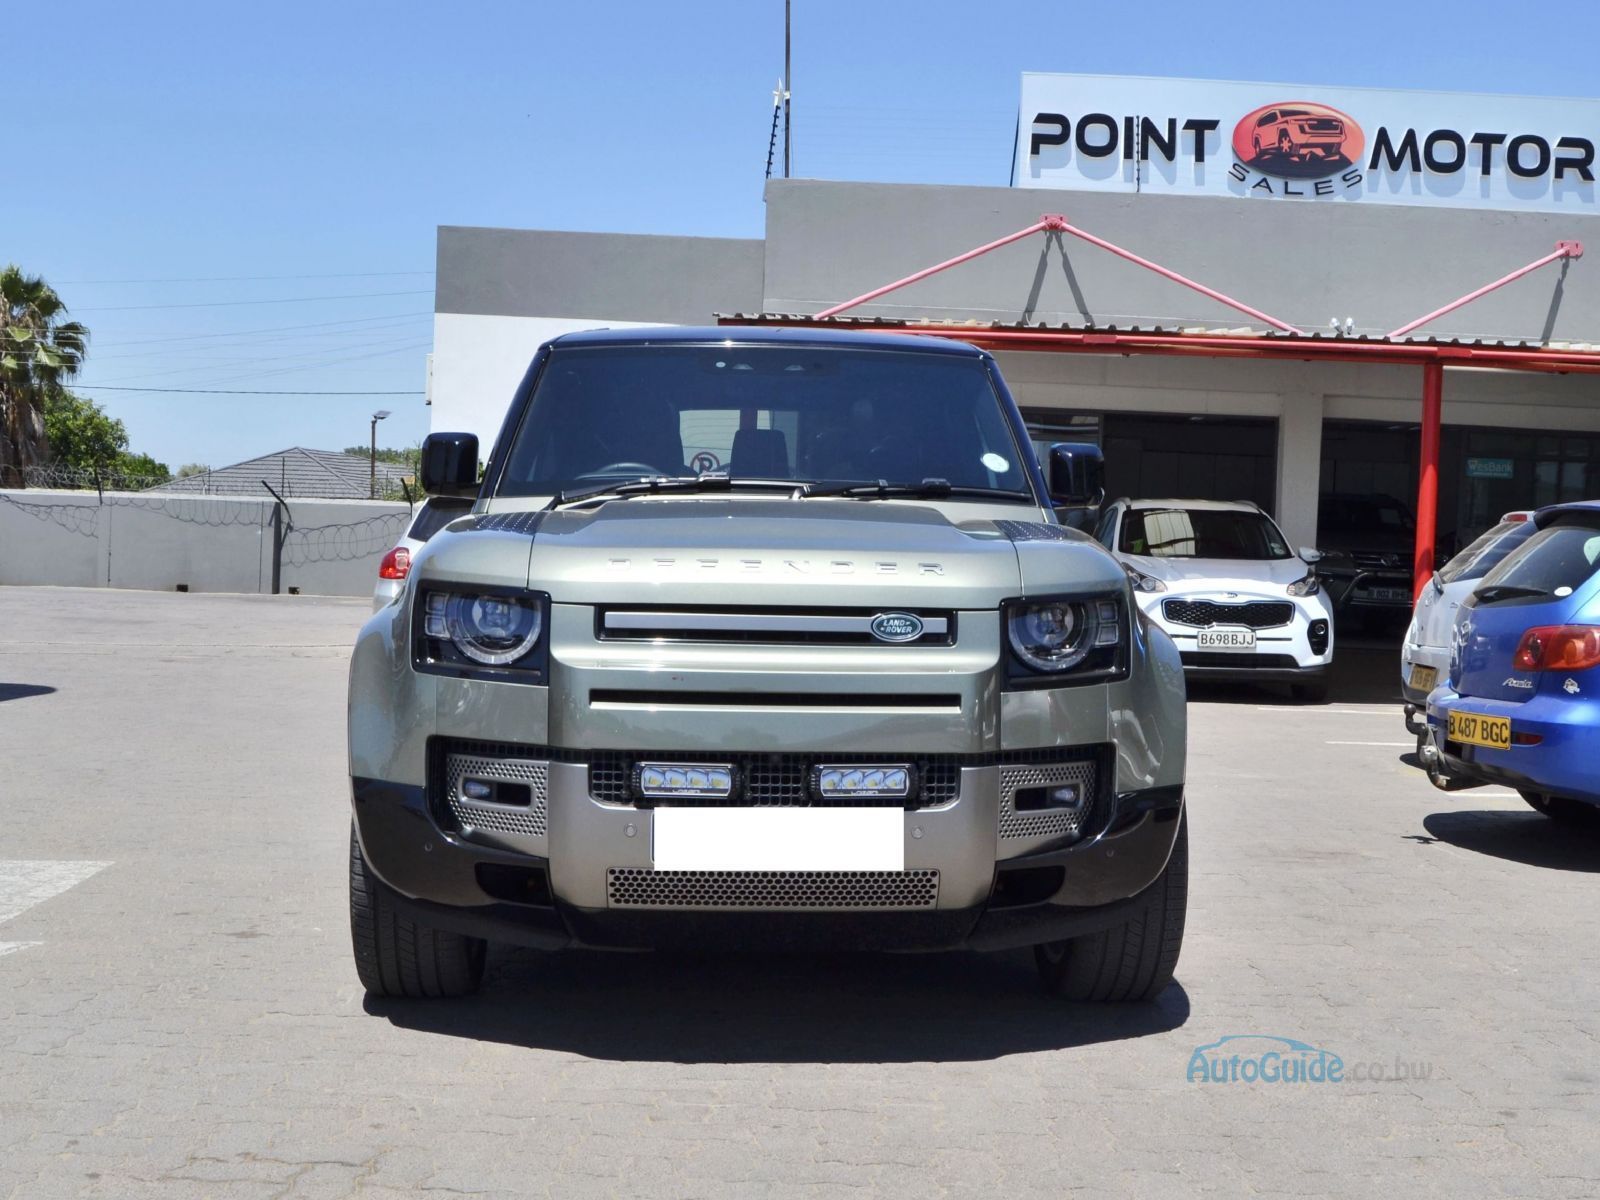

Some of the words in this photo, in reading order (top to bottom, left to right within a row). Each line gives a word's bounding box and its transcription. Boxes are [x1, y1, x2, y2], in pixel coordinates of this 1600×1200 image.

[1031, 113, 1220, 163] POINT
[1368, 126, 1596, 182] MOTOR
[1228, 162, 1363, 196] SALES
[1467, 459, 1513, 473] WesBank
[883, 619, 905, 627] LAND
[886, 626, 912, 634] ROVER
[1449, 715, 1456, 735] B
[1458, 717, 1477, 739] 487
[1481, 720, 1509, 744] BGC
